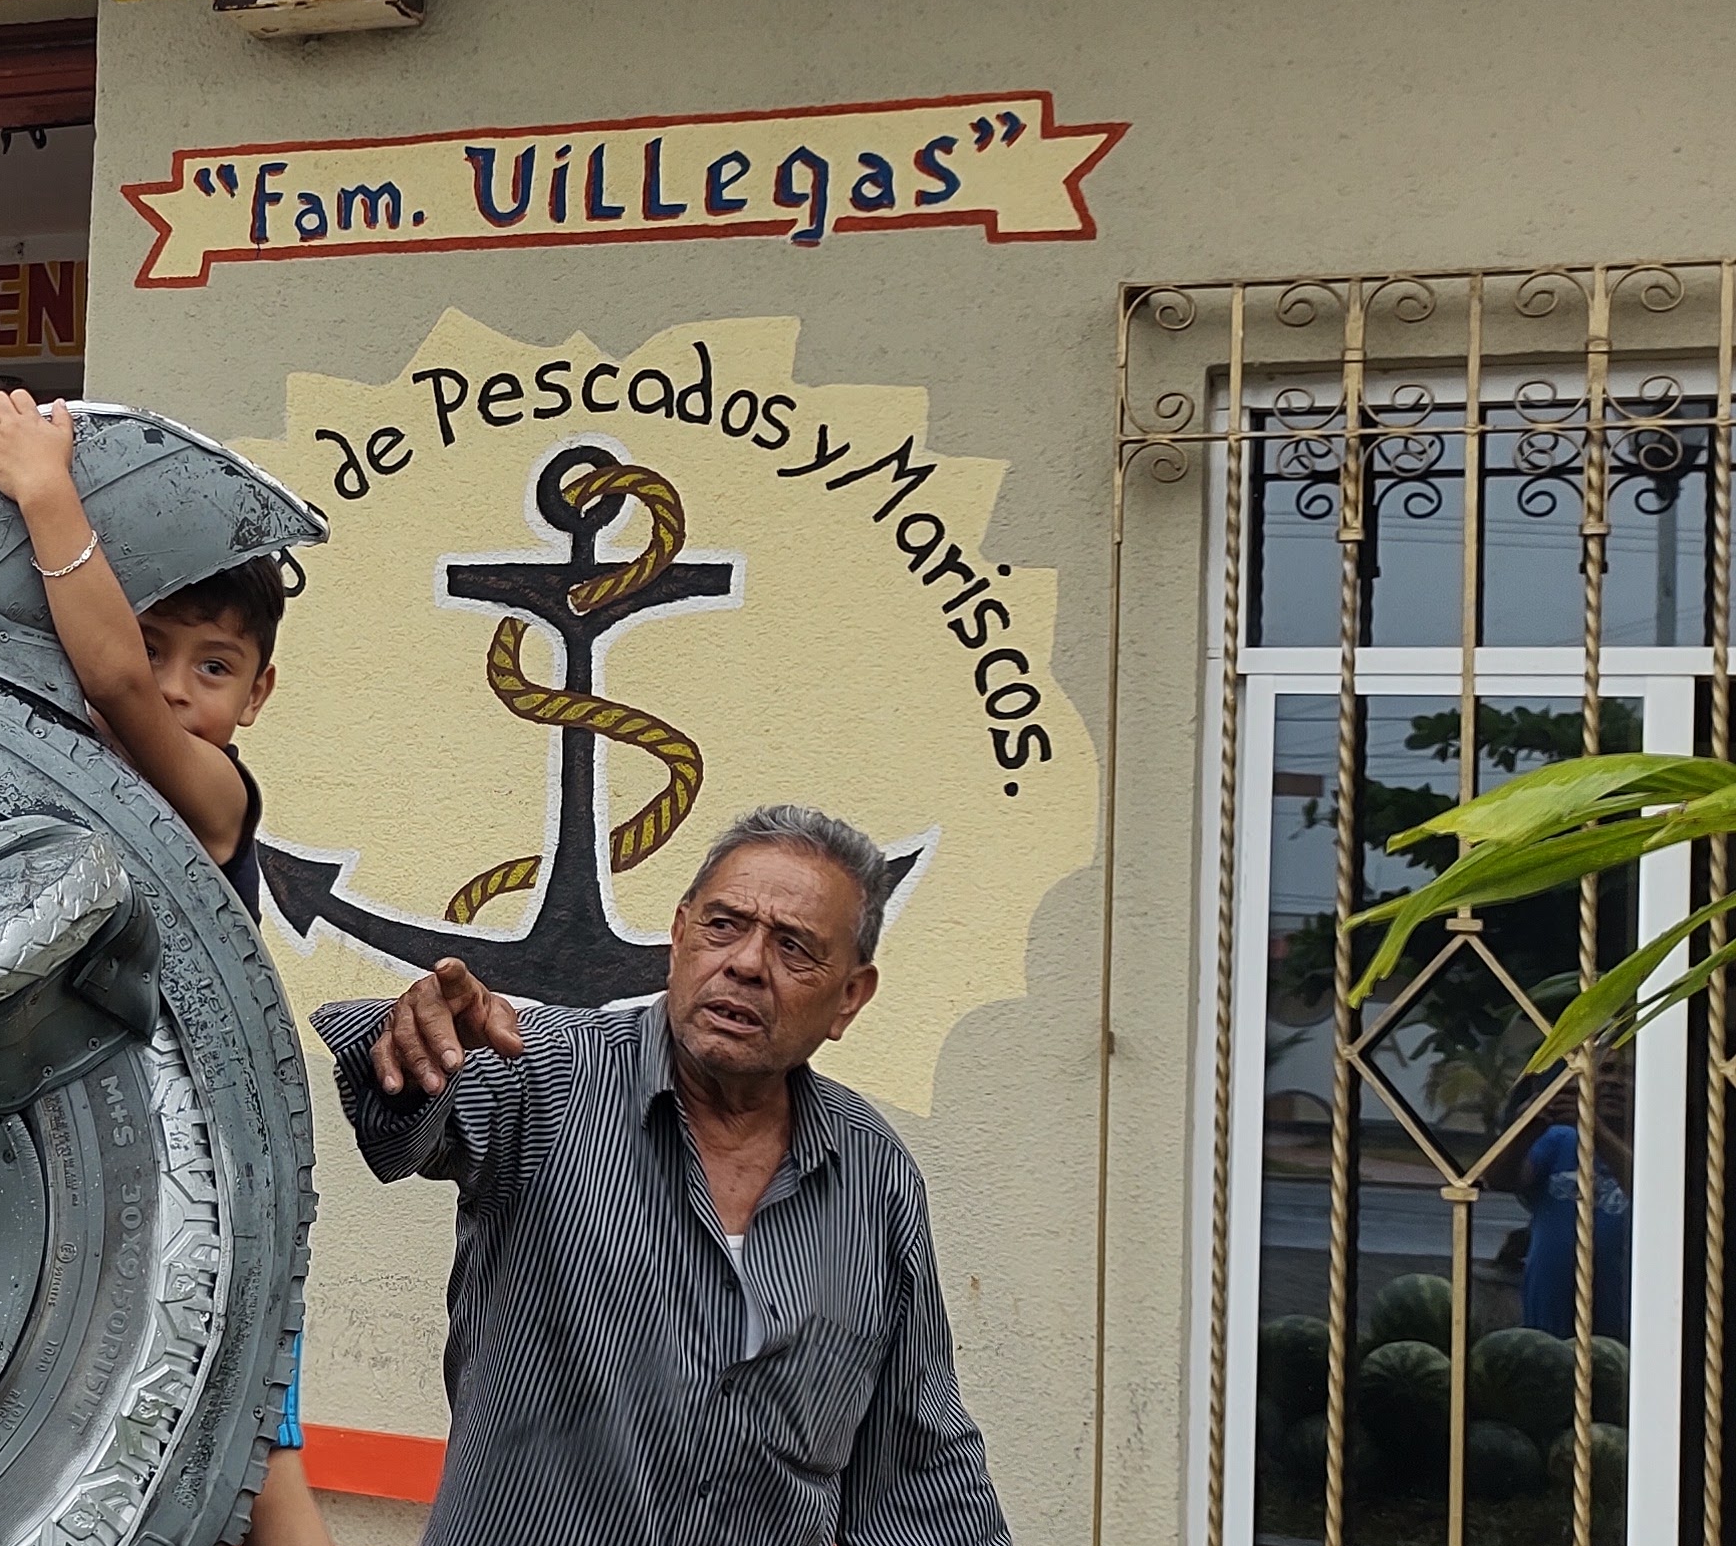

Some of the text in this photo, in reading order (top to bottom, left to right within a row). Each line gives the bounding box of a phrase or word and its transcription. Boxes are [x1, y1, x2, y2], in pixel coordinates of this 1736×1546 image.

[314, 426, 414, 500] de
[412, 340, 796, 453] Pescados
[776, 422, 852, 480] y
